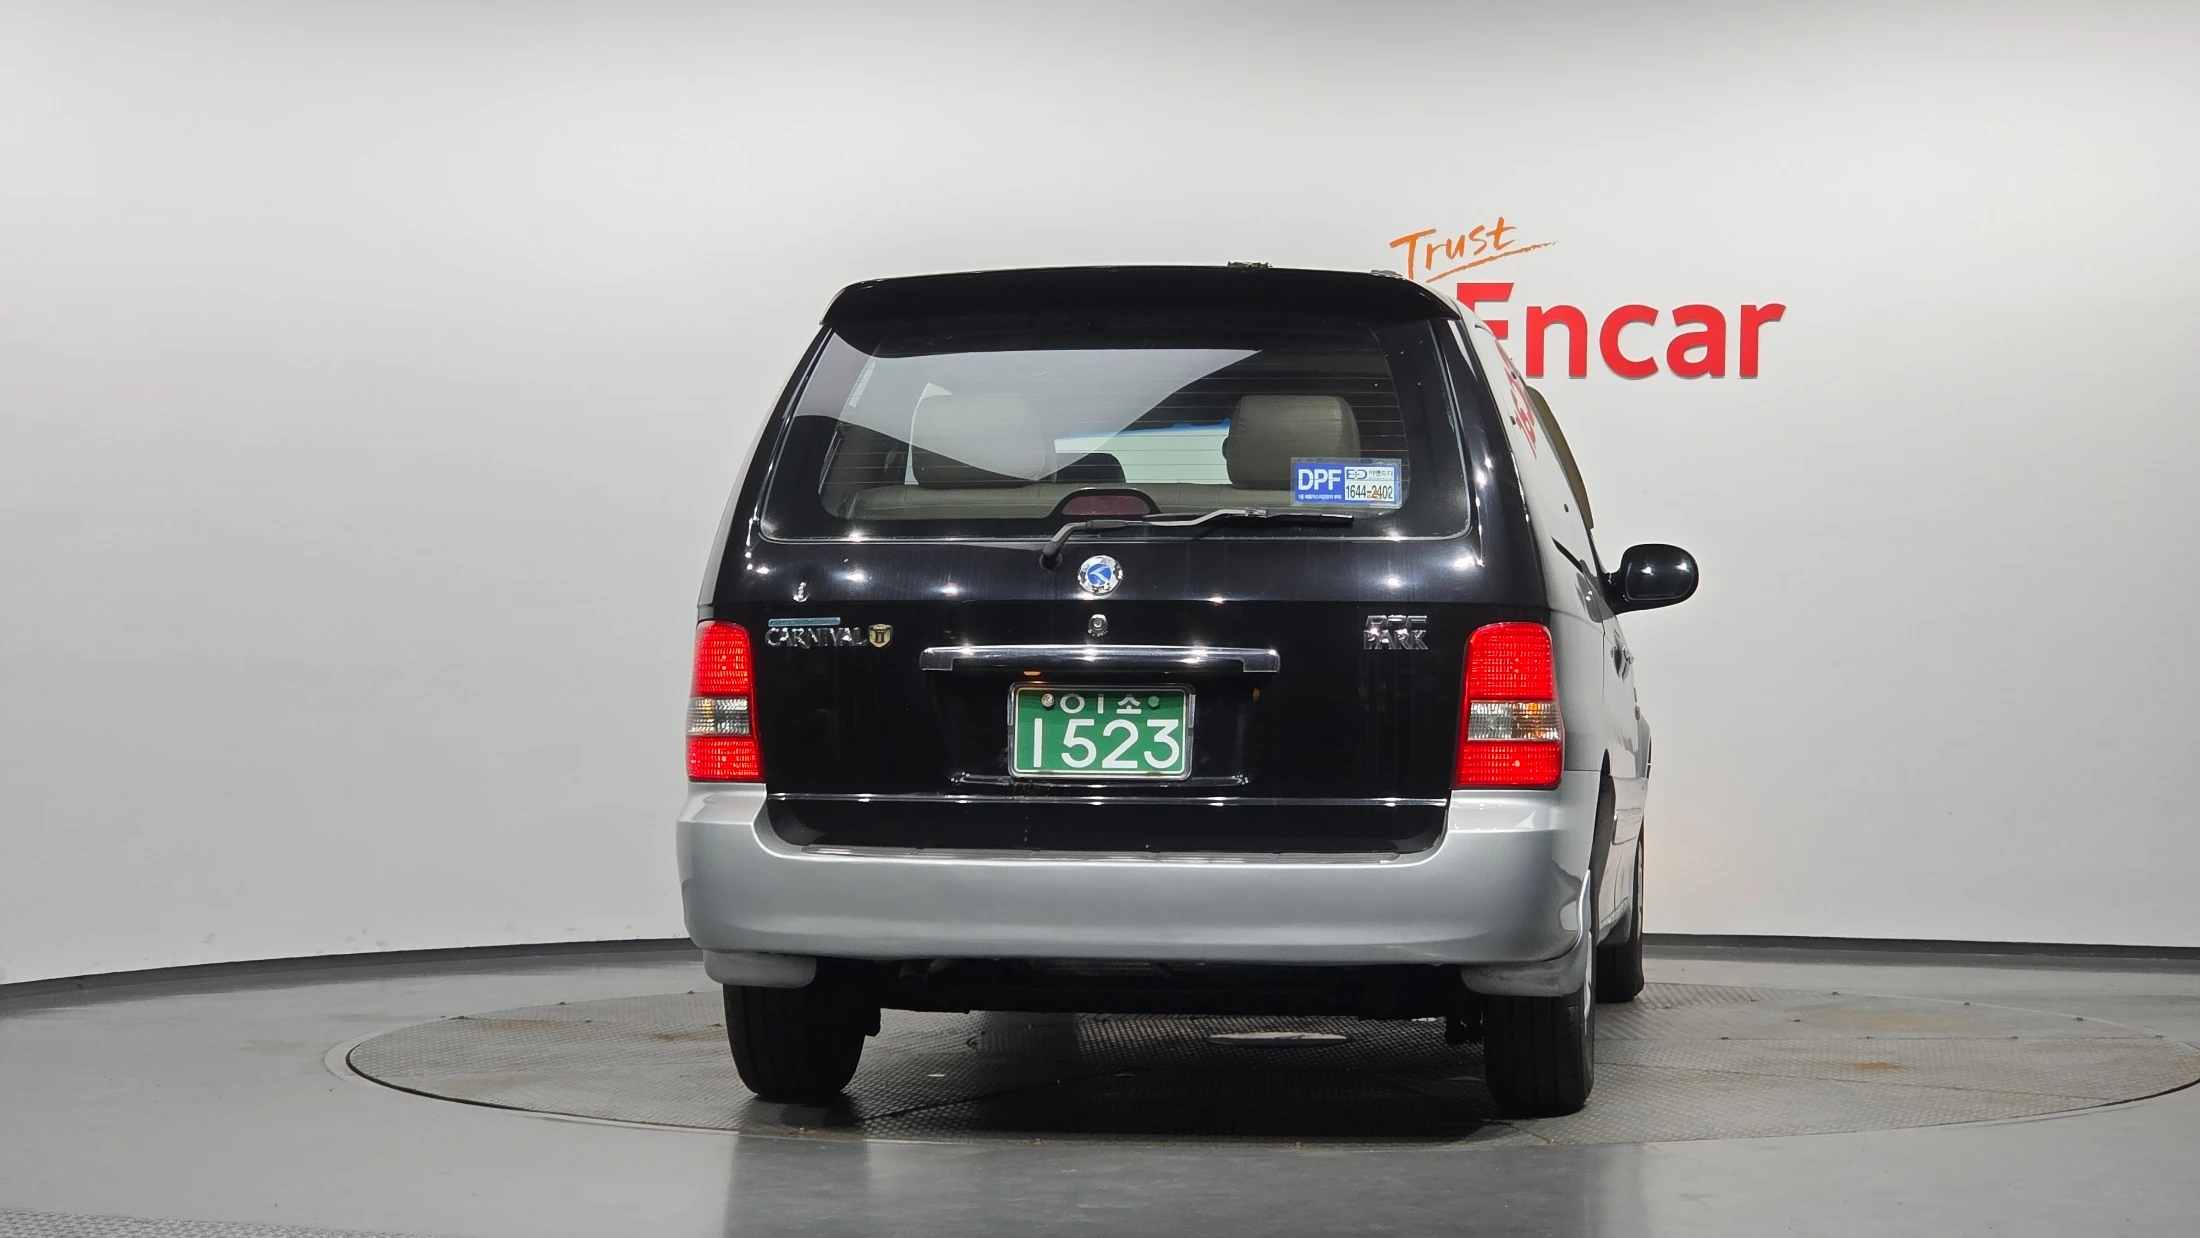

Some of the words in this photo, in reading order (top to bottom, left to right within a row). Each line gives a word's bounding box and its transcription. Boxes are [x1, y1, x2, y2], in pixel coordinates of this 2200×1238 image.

[1389, 216, 1518, 281] Trust
[1297, 468, 1342, 491] DPF
[1345, 484, 1394, 499] 1644-2402
[764, 627, 867, 649] CARNIVAL
[1362, 628, 1429, 650] PARK
[1033, 718, 1180, 769] 1523
